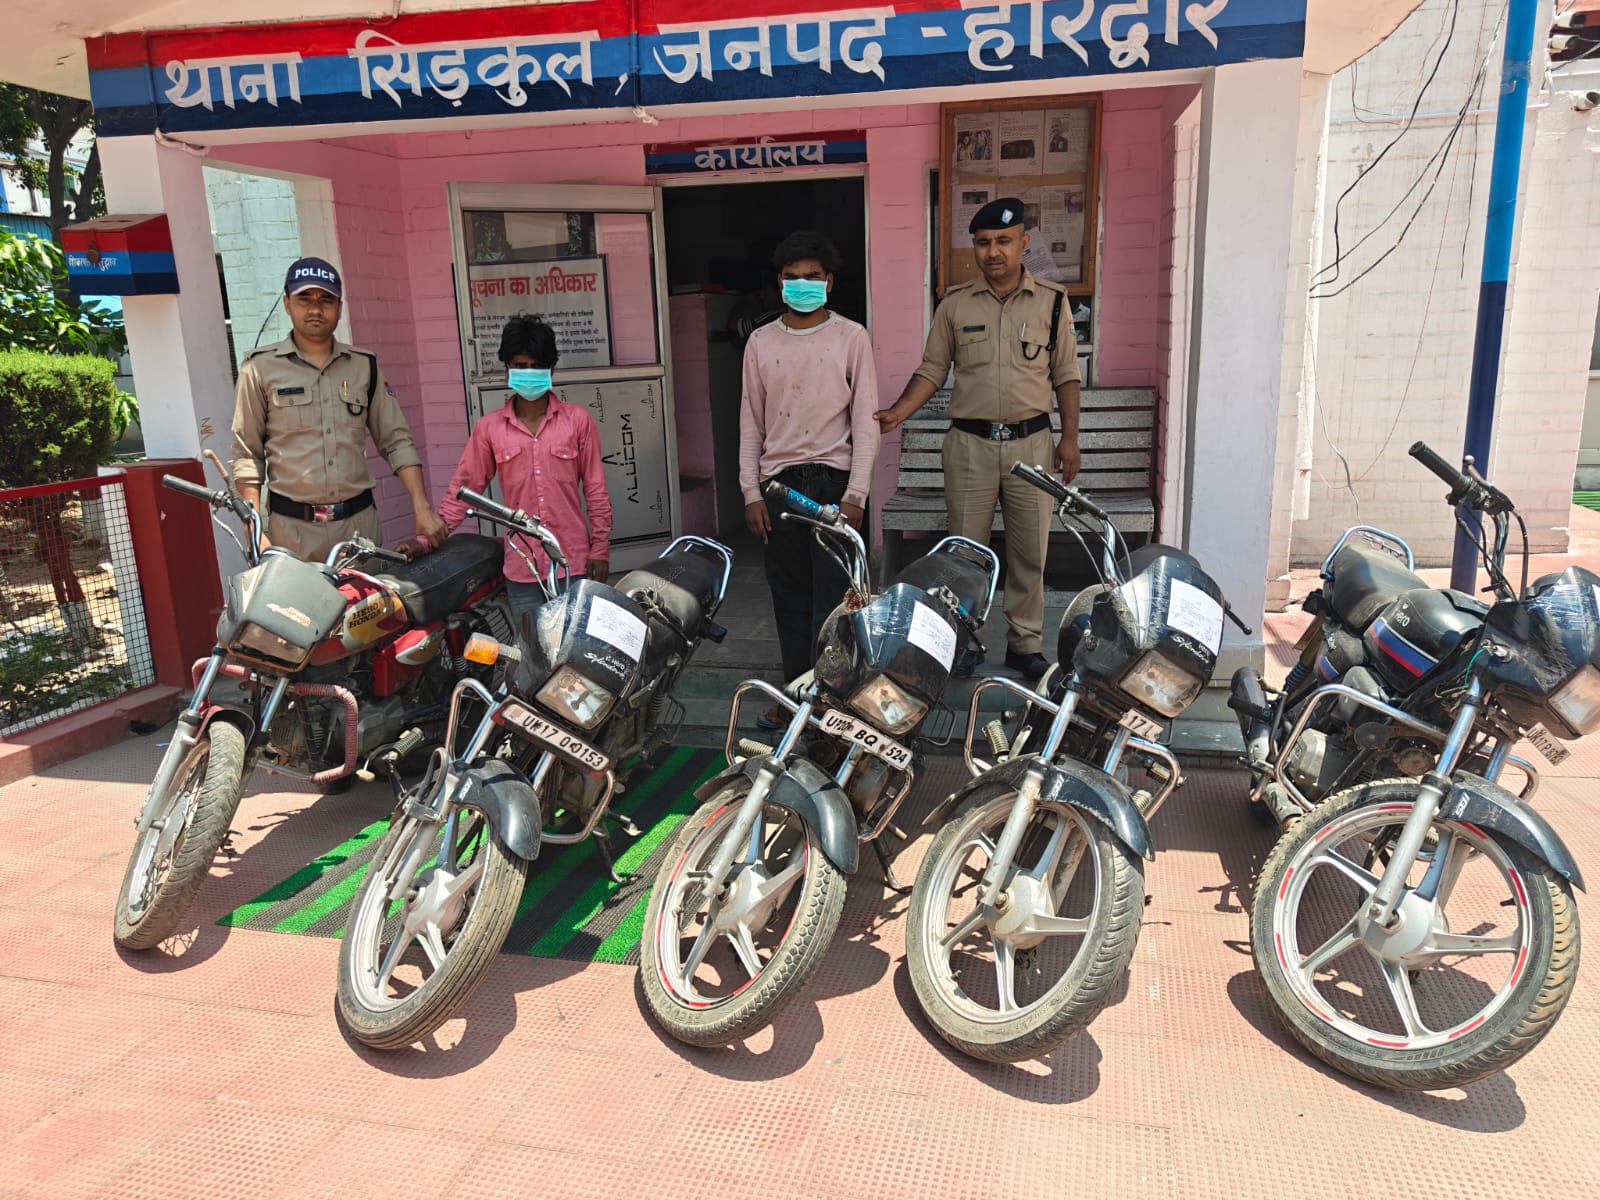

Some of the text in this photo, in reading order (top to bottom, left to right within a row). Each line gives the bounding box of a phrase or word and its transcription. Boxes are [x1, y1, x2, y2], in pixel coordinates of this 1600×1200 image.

[164, 51, 303, 112] थाना
[652, 5, 896, 84] जनपद
[694, 135, 827, 171] कार्यालय
[295, 267, 336, 283] POLICE
[509, 276, 531, 296] का
[535, 266, 598, 295] अधिकार
[348, 610, 381, 628] HONDA
[352, 602, 379, 619] HERO
[853, 729, 878, 747] BQ
[885, 747, 908, 763] 524
